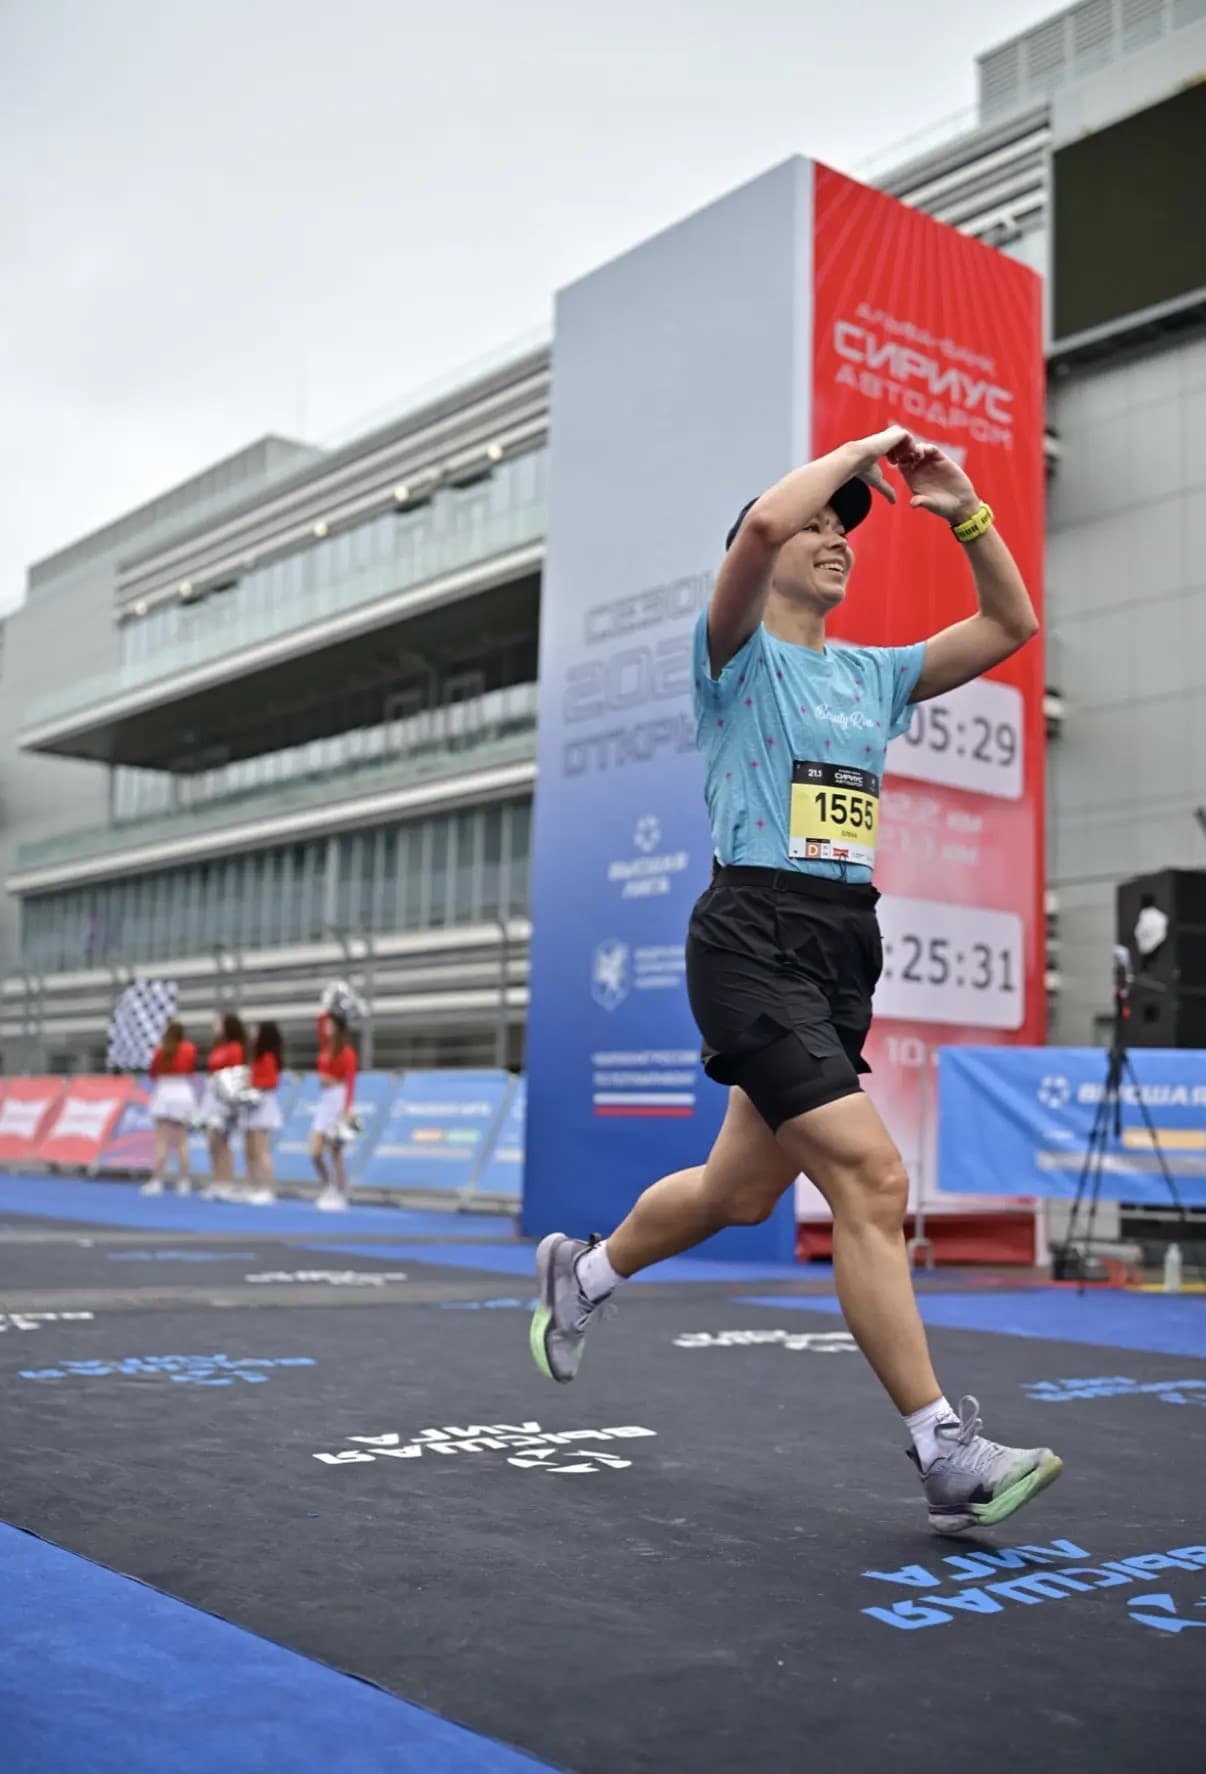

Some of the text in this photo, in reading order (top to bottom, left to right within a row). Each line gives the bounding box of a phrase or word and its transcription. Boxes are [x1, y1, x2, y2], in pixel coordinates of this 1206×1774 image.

[833, 320, 1014, 424] СИРИУС
[815, 792, 873, 831] 1555
[312, 1426, 657, 1465] ВЫСШАЯ
[346, 1422, 541, 1446] ЛИГА
[861, 1539, 1091, 1588] ЛИГА
